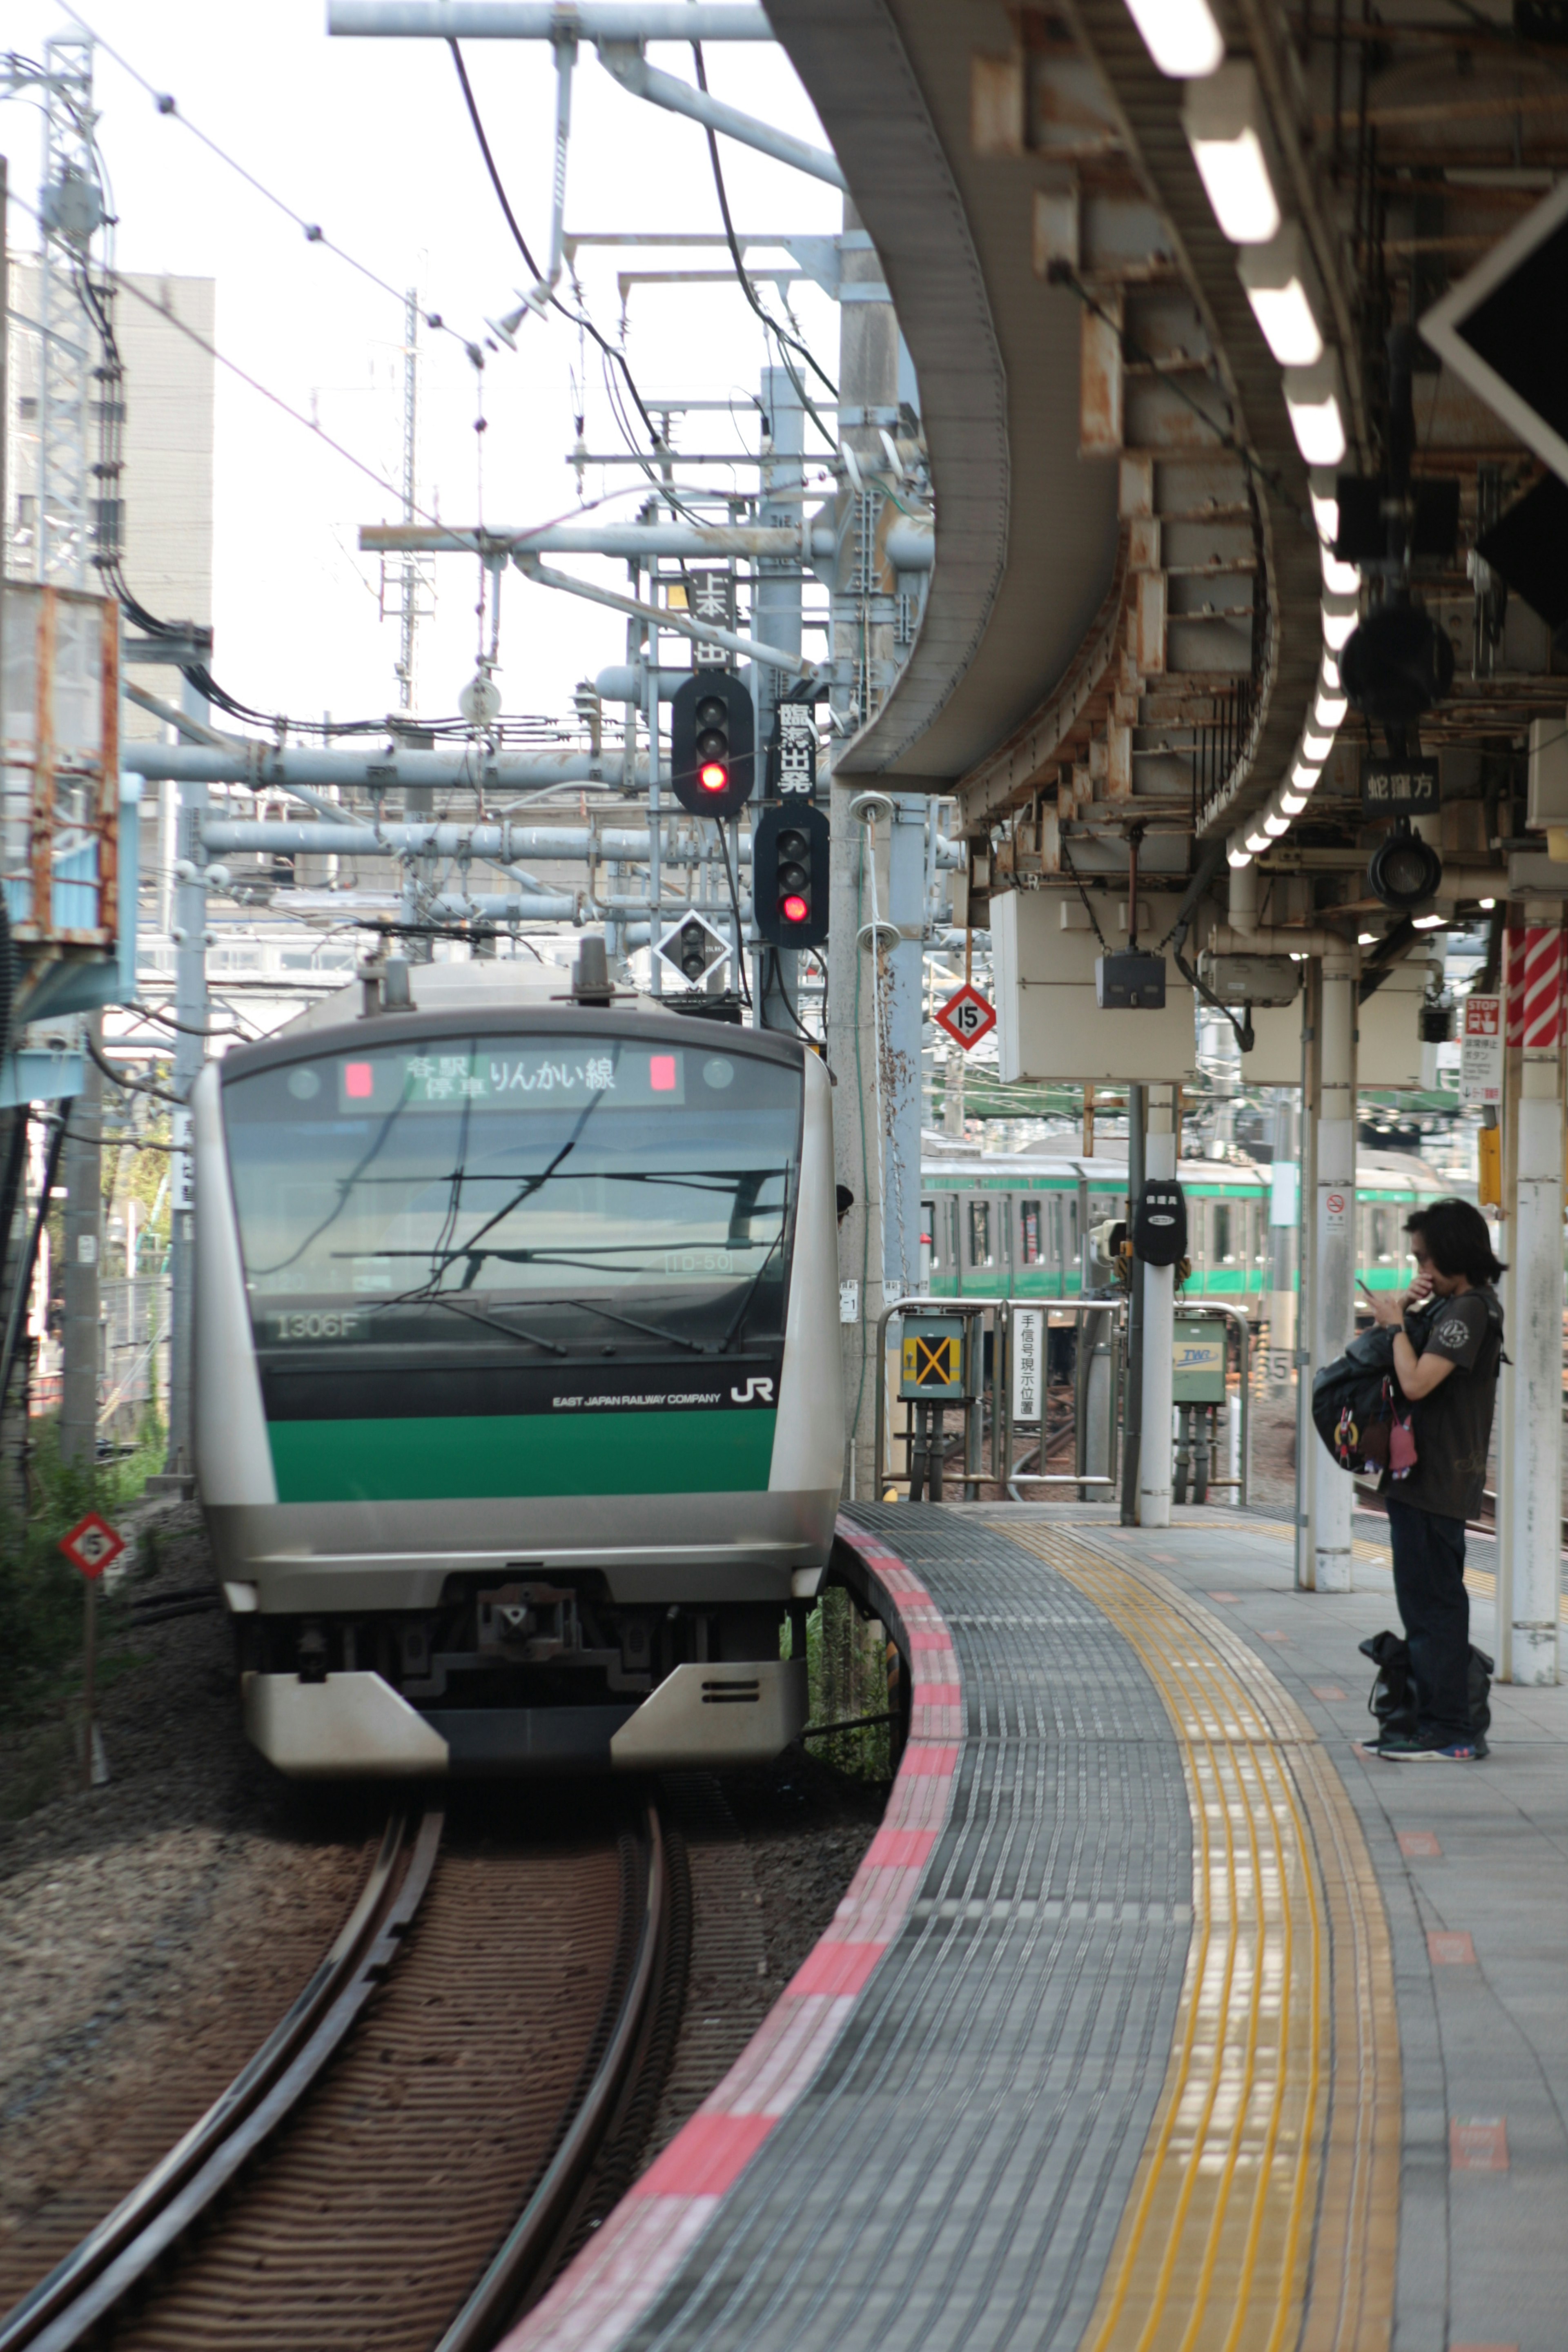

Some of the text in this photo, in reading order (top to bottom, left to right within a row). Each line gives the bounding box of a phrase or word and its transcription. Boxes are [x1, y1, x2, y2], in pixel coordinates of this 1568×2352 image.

[1468, 1000, 1497, 1011] STOP
[958, 1007, 978, 1028] 15
[407, 1056, 468, 1078] 各駅
[490, 1058, 615, 1091] りんかい線
[425, 1078, 487, 1099] 停車
[278, 1313, 359, 1338] 1306F
[1021, 1314, 1035, 1414] 手信号現示位置
[553, 1393, 721, 1407] EAST JAPAN RAILWAY COMPANY
[731, 1377, 773, 1403] JR
[83, 1534, 102, 1555] 15
